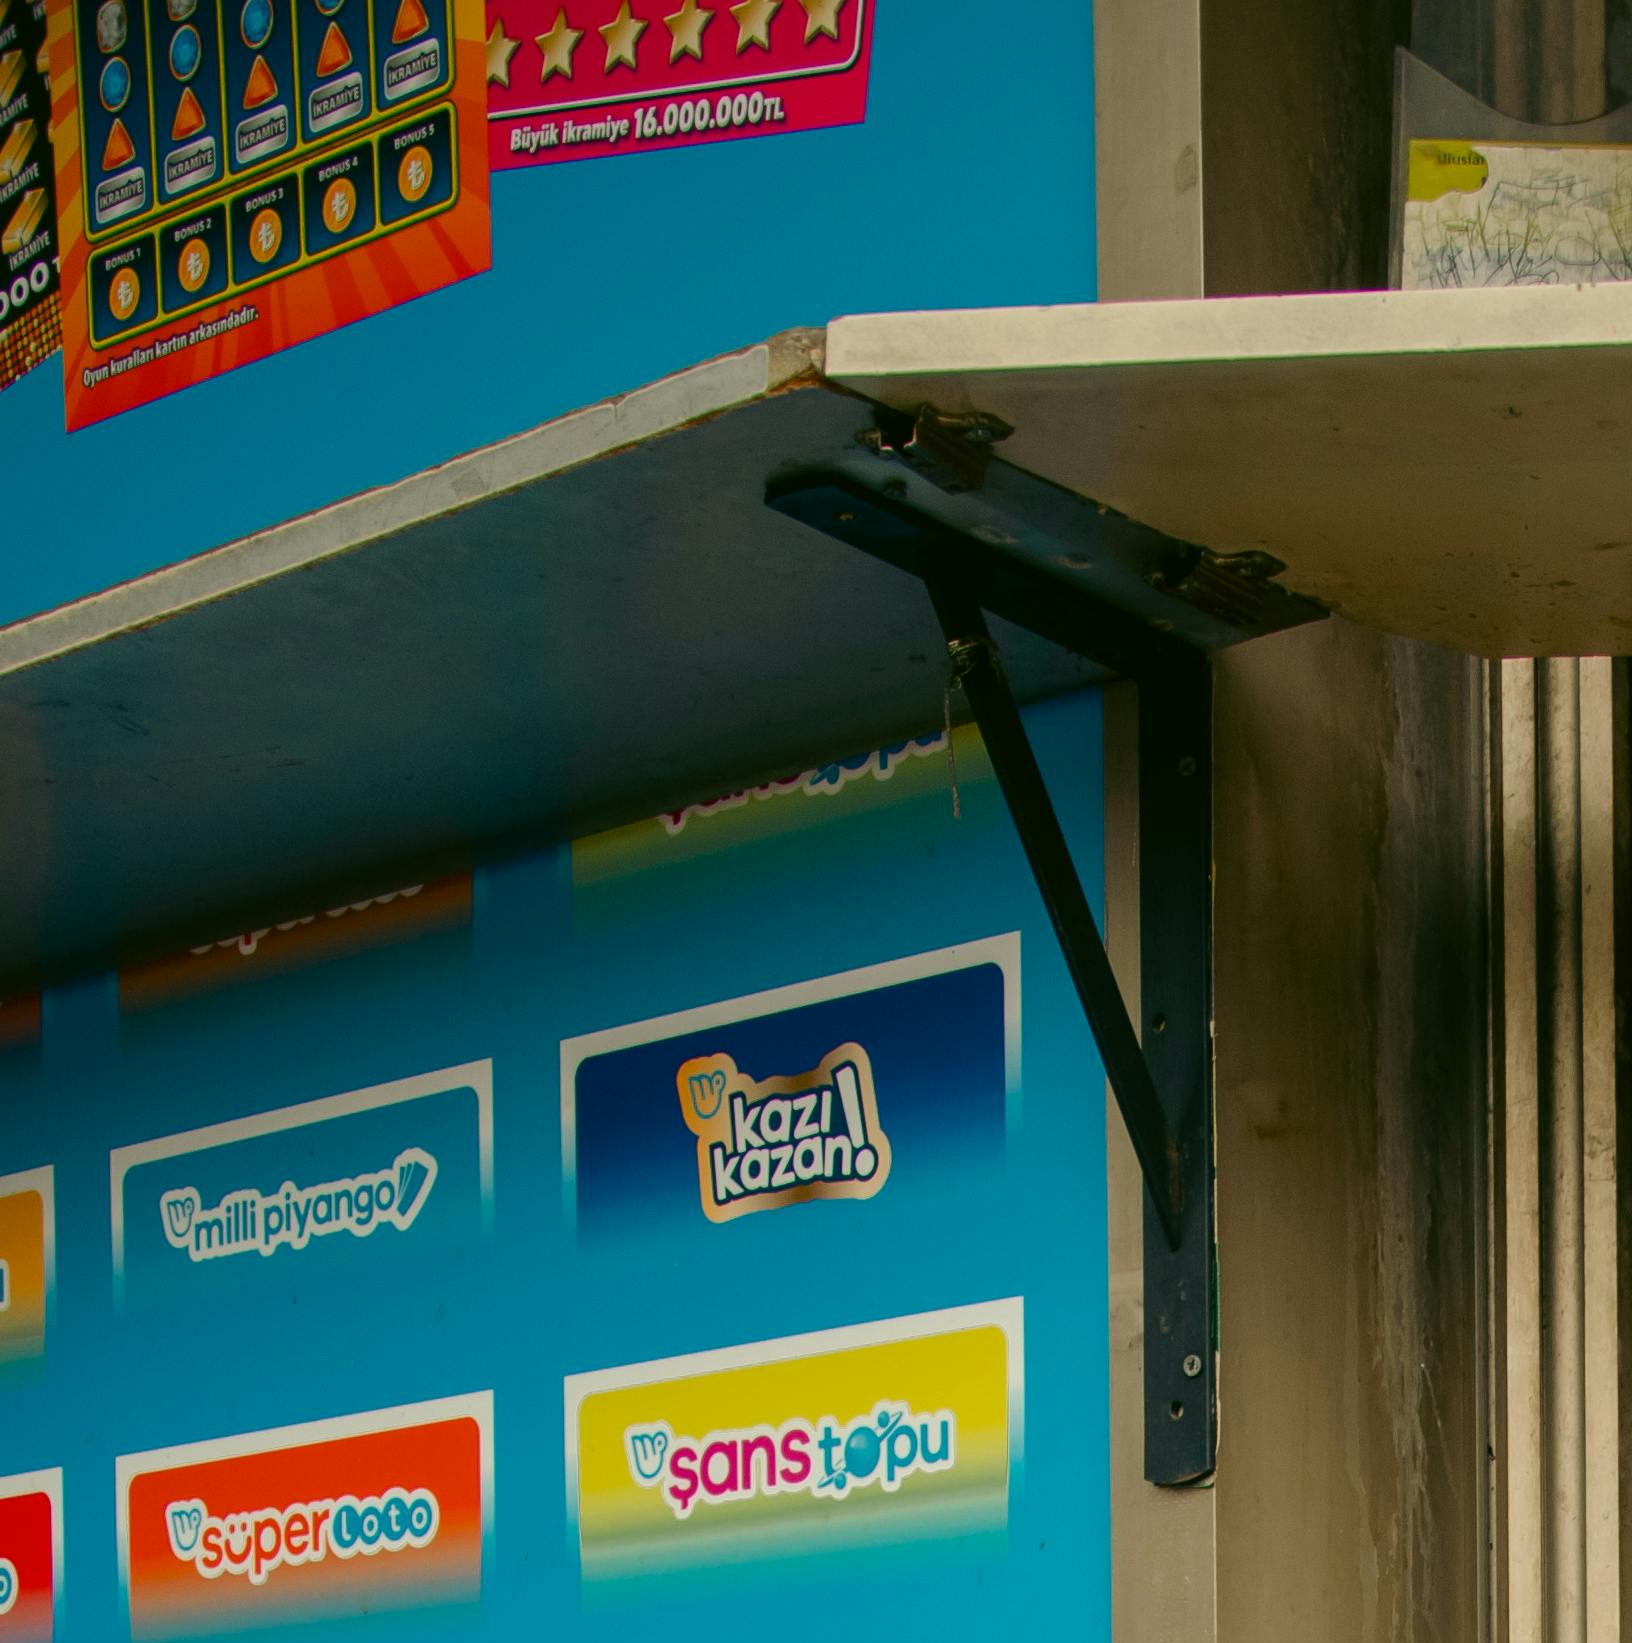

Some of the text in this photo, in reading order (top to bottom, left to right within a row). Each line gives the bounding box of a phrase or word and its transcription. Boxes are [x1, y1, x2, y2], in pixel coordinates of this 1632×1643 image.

[394, 124, 435, 150] BONUS 5
[511, 122, 559, 153] Büyük
[318, 157, 358, 182] BONUS 4
[245, 188, 284, 212] BONUS 3
[174, 218, 212, 242] BONUS 2
[105, 250, 135, 271] BONUS
[83, 366, 109, 388] Oyun
[110, 348, 154, 376] kuralları
[155, 335, 188, 360] kartın
[733, 1090, 832, 1152] kazı
[194, 1178, 396, 1251] milli piyango
[668, 1415, 950, 1510] şans topu
